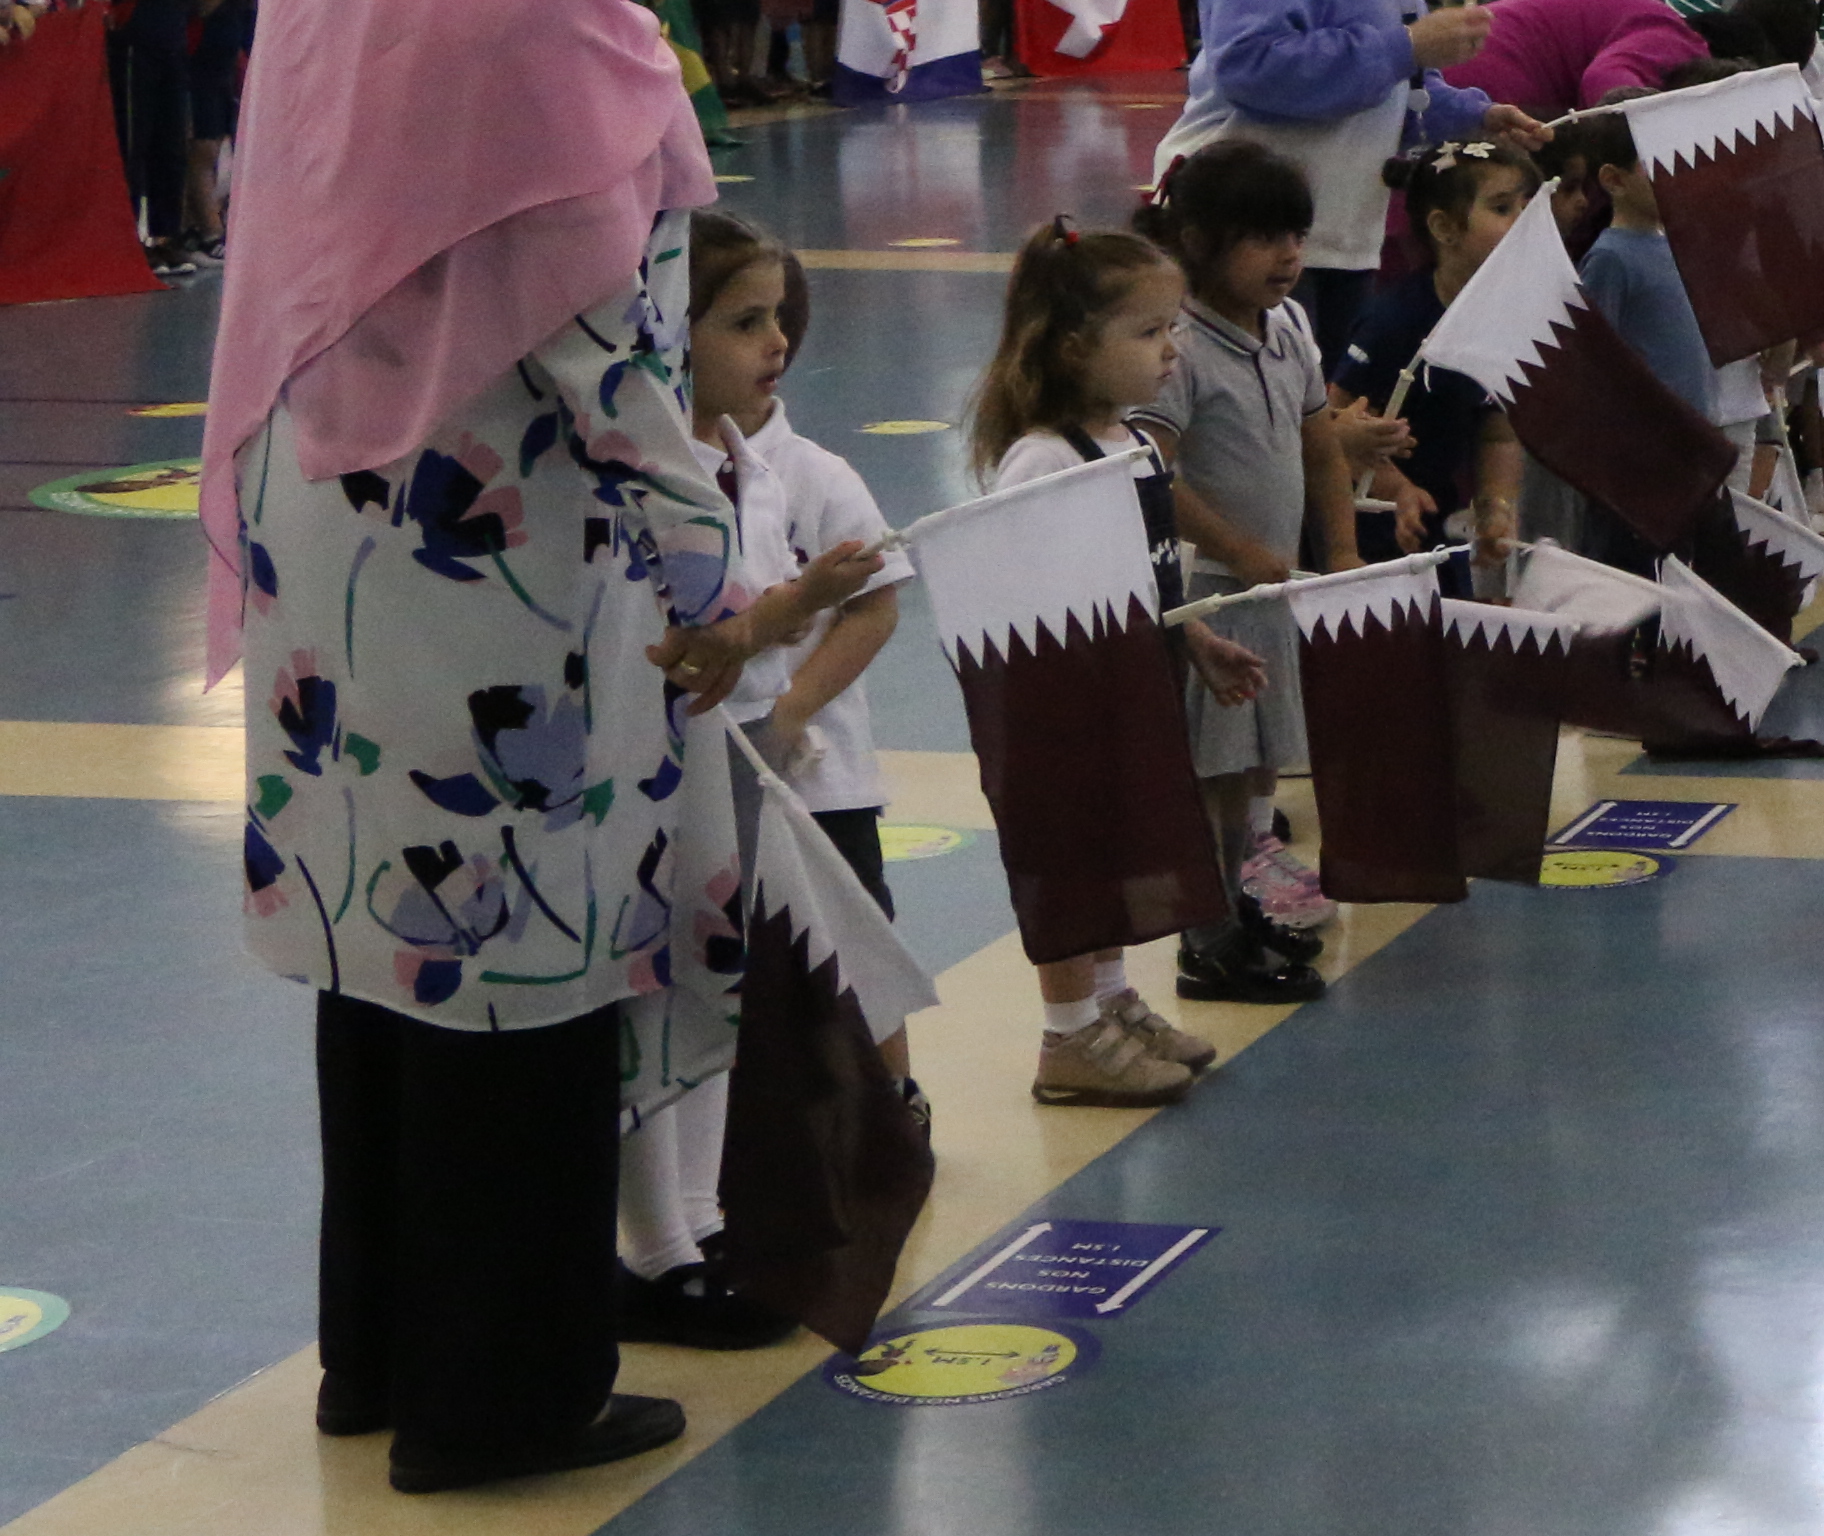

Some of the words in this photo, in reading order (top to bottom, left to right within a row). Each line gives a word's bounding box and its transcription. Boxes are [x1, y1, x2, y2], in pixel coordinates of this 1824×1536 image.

[1013, 1254, 1151, 1267] DISTANCES
[1037, 1269, 1090, 1279] NOS
[985, 1281, 1107, 1294] GARDONS
